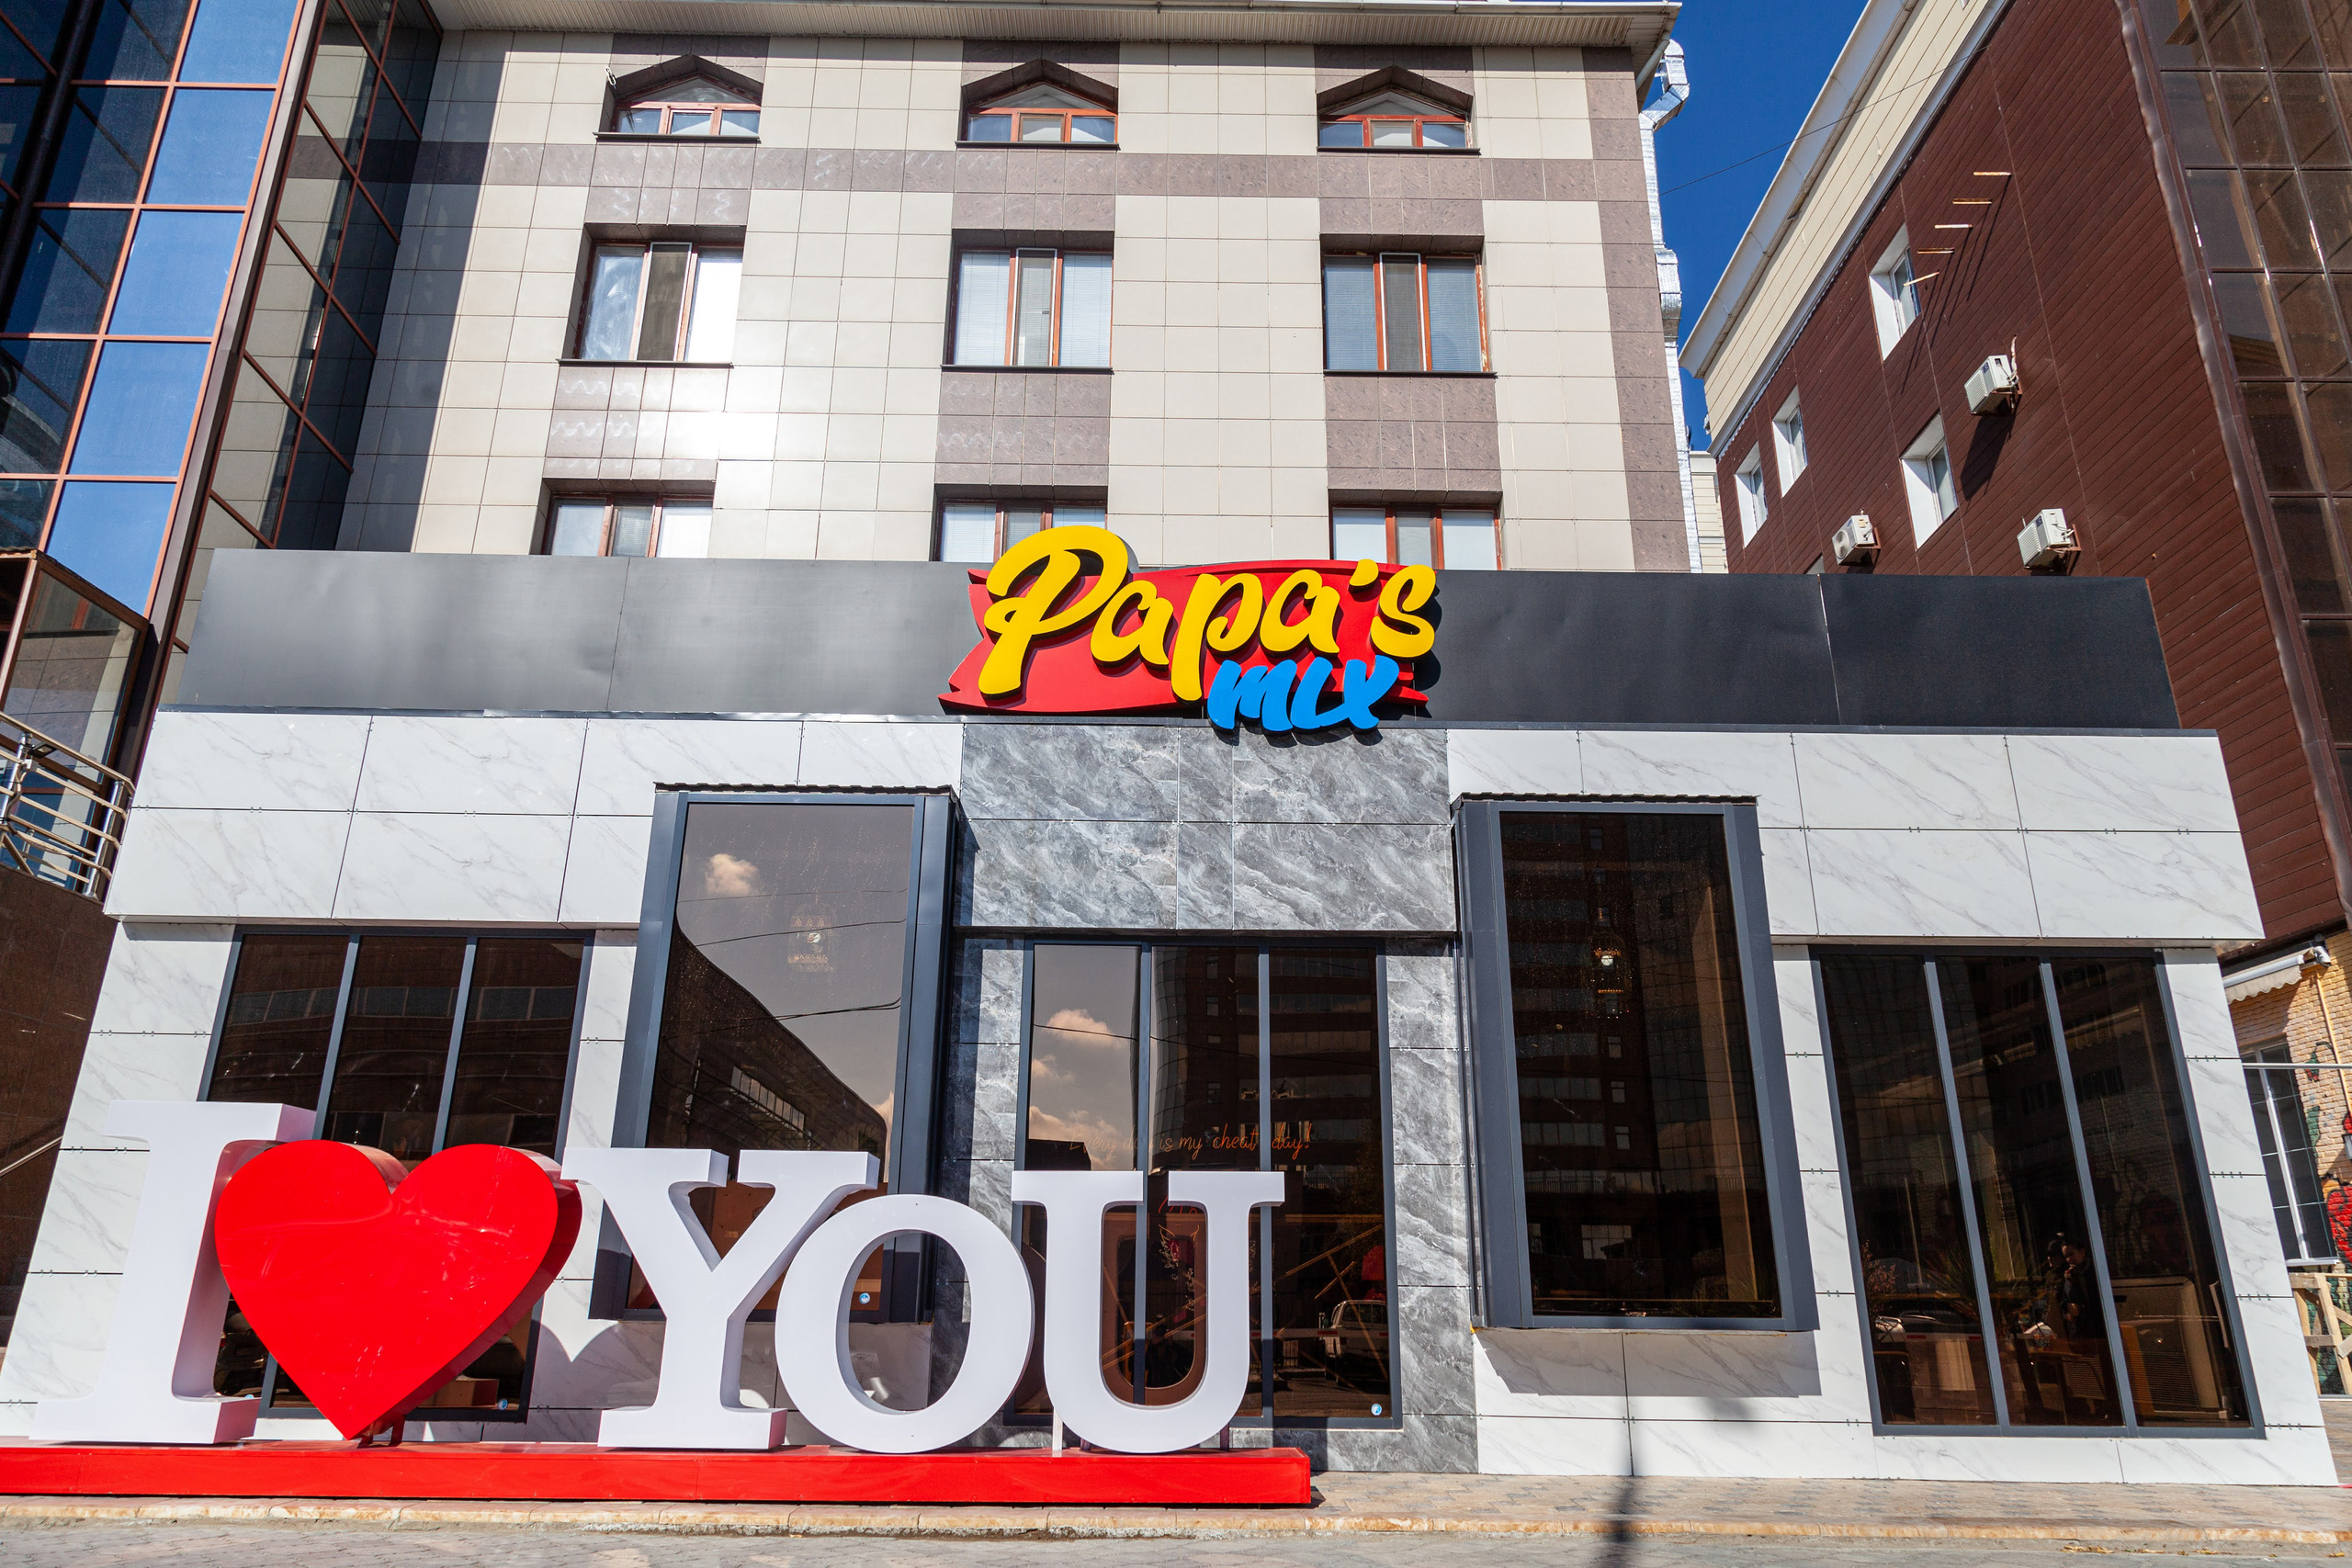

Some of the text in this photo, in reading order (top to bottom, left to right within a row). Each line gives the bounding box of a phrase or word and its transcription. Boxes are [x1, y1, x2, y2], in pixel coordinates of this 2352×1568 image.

[977, 525, 1436, 702] Papa's
[1159, 1133, 1173, 1153] is
[1179, 1135, 1203, 1160] my
[1212, 1122, 1260, 1151] cheat
[1272, 1122, 1312, 1160] day!
[28, 1101, 1285, 1453] I YOU
